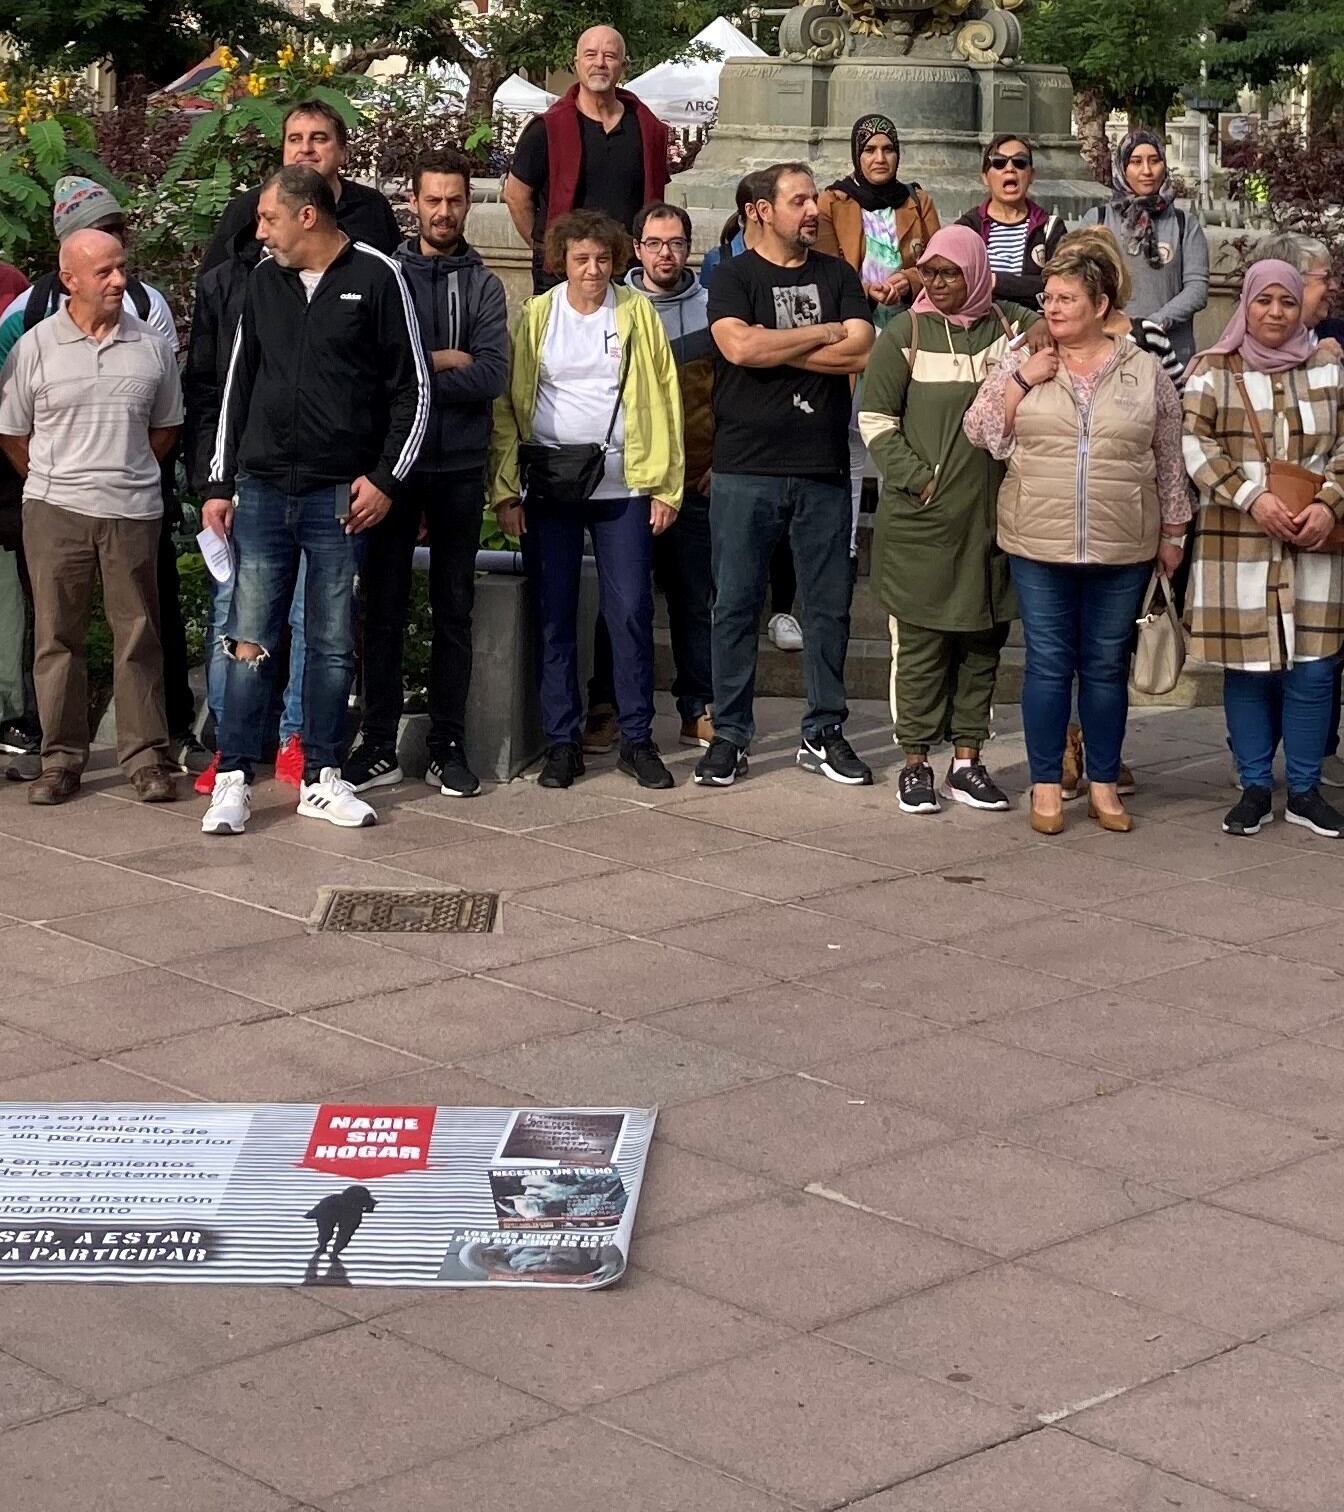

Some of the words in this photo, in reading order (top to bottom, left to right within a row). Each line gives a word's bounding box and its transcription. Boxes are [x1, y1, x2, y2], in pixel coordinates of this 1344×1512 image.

[329, 1116, 419, 1130] NADIE
[42, 1124, 174, 1134] alojamiento
[142, 1137, 234, 1146] superior
[345, 1131, 398, 1143] SIN
[315, 1145, 420, 1160] HOGAR
[48, 1159, 196, 1168] alojamientos
[31, 1169, 52, 1177] lo
[60, 1169, 220, 1179] estrictamente
[90, 1194, 213, 1204] institución
[74, 1232, 93, 1244] A
[102, 1231, 201, 1244] ESTAR
[1, 1248, 20, 1260] A
[29, 1247, 207, 1262] PARTICIPAR
